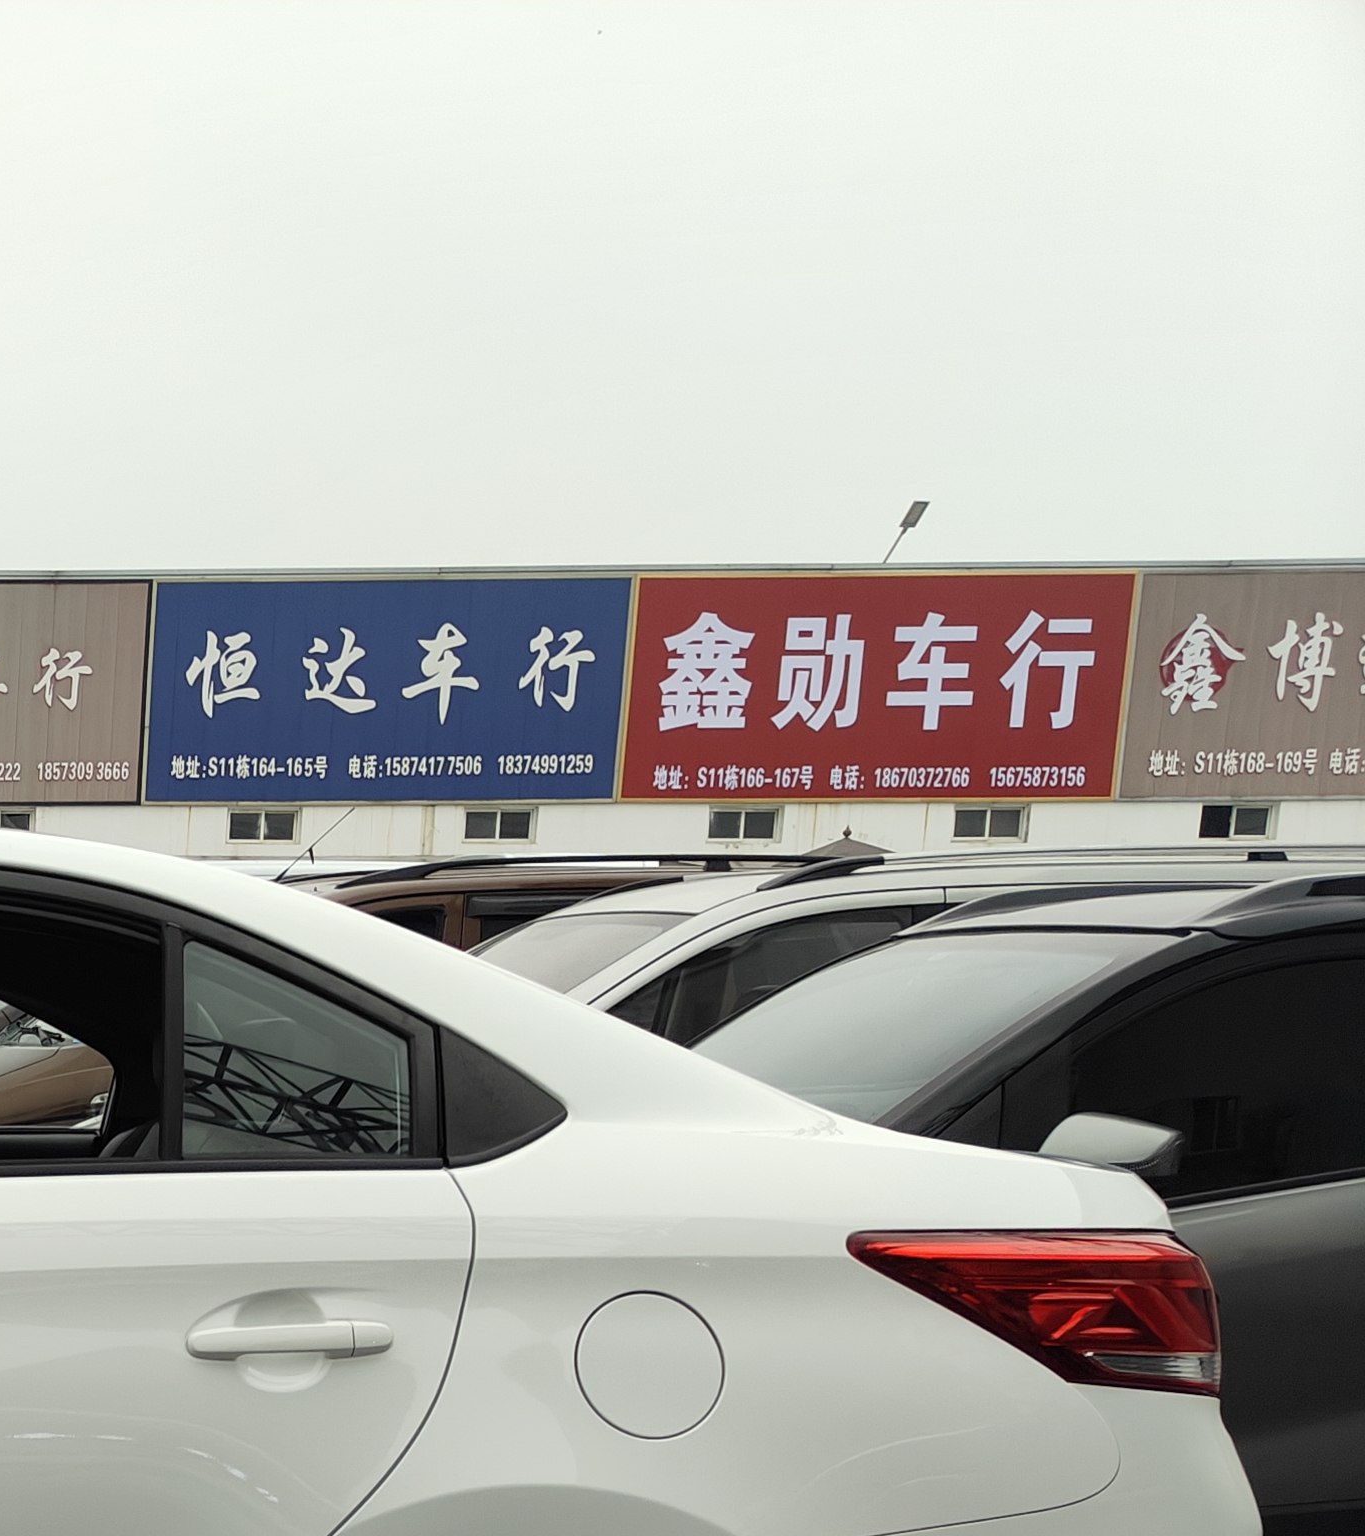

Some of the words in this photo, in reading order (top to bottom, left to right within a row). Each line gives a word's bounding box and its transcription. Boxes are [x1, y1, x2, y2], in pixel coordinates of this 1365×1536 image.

[185, 622, 596, 725] 恒达车行
[658, 610, 1096, 732] 鑫勋车行
[1159, 611, 1365, 715] 鑫博
[497, 754, 594, 775] 18374991259
[989, 766, 1086, 788] 15675873156
